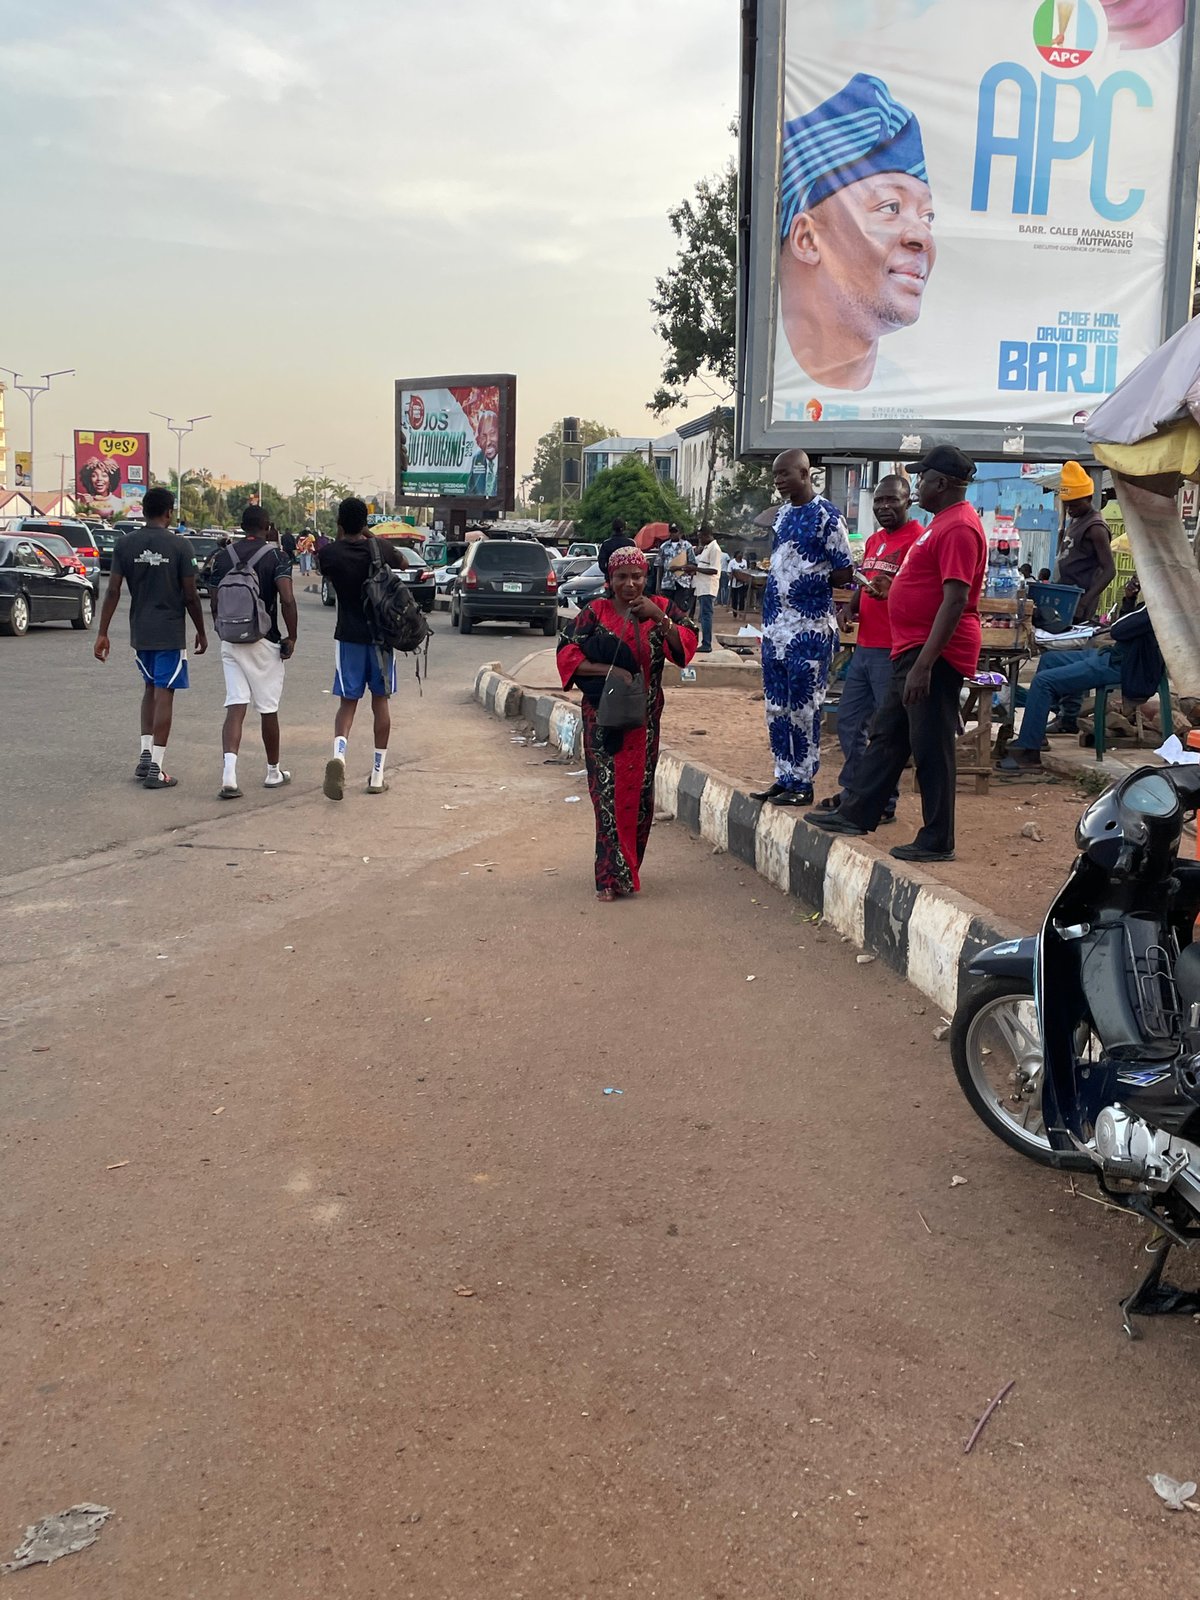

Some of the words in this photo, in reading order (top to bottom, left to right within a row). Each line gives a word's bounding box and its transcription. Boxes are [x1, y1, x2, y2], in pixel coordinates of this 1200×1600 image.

[1049, 50, 1080, 64] APC
[970, 61, 1153, 222] APC
[1018, 224, 1046, 234] BARR.
[1049, 226, 1078, 236] CALEB
[1081, 228, 1134, 240] MANASSEH
[1076, 237, 1133, 248] MUTFWANG
[1058, 311, 1091, 326] CHIEF
[1093, 312, 1120, 328] HON.
[1036, 326, 1073, 342] DAVID
[1076, 328, 1119, 343] BITRUS
[998, 340, 1118, 394] BARJI
[423, 412, 448, 431] JOS
[408, 431, 466, 467] OUTPOURING
[375, 515, 393, 523] POS
